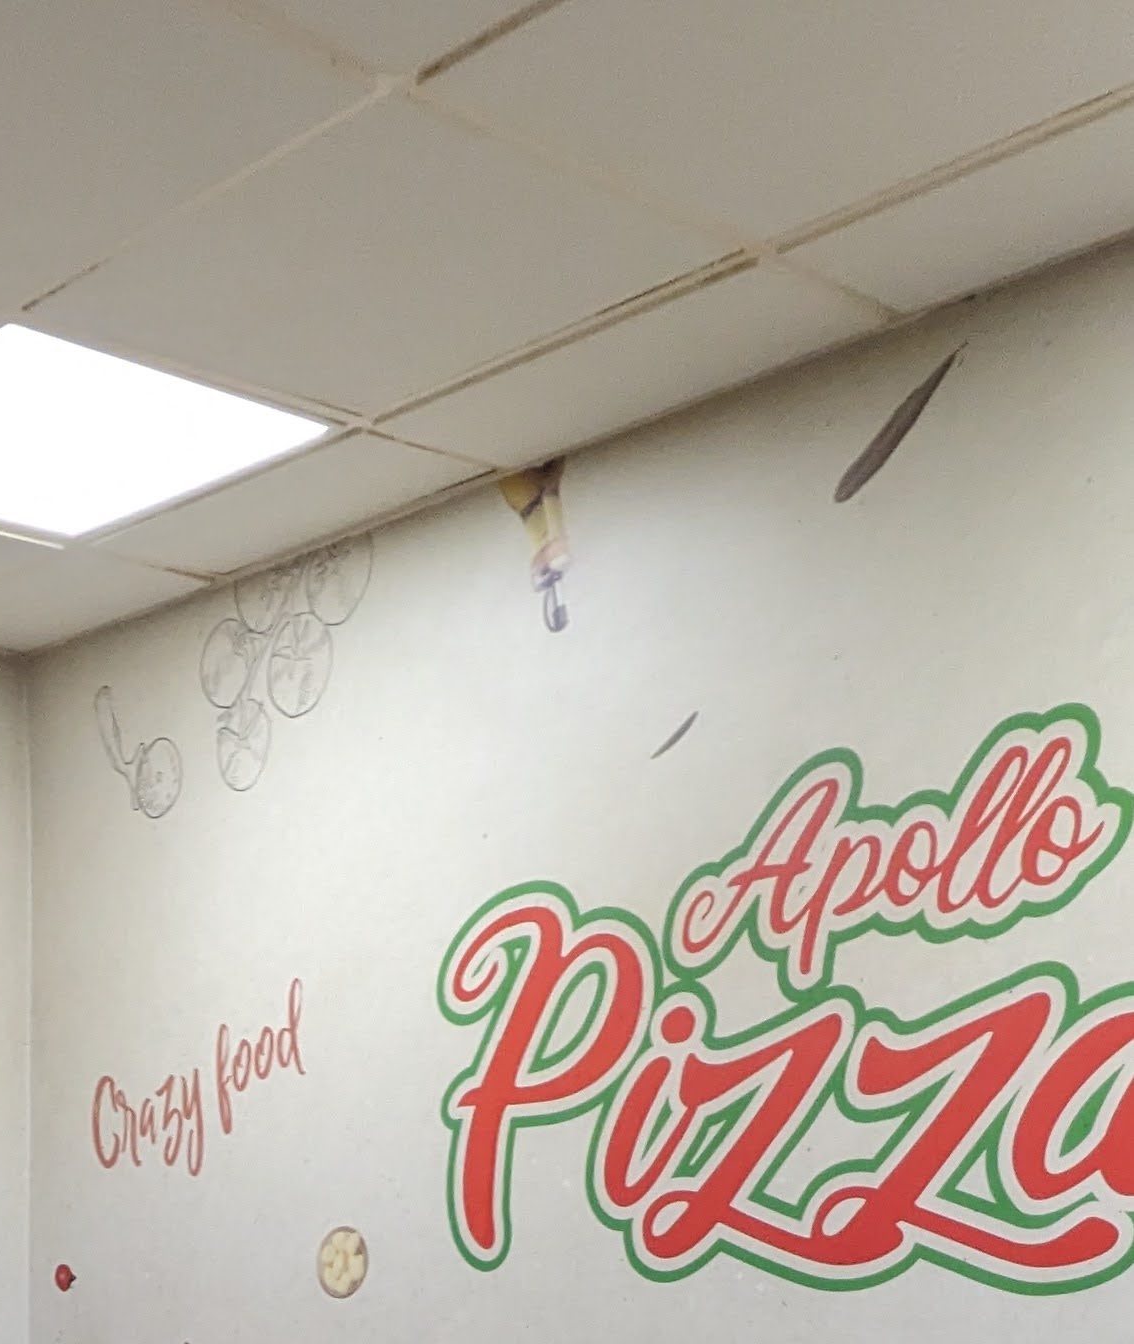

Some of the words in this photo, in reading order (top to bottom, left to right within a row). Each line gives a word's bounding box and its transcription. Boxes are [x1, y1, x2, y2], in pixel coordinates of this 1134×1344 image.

[683, 736, 1104, 974] Apollo
[91, 1067, 206, 1177] Crazy
[215, 977, 307, 1135] food
